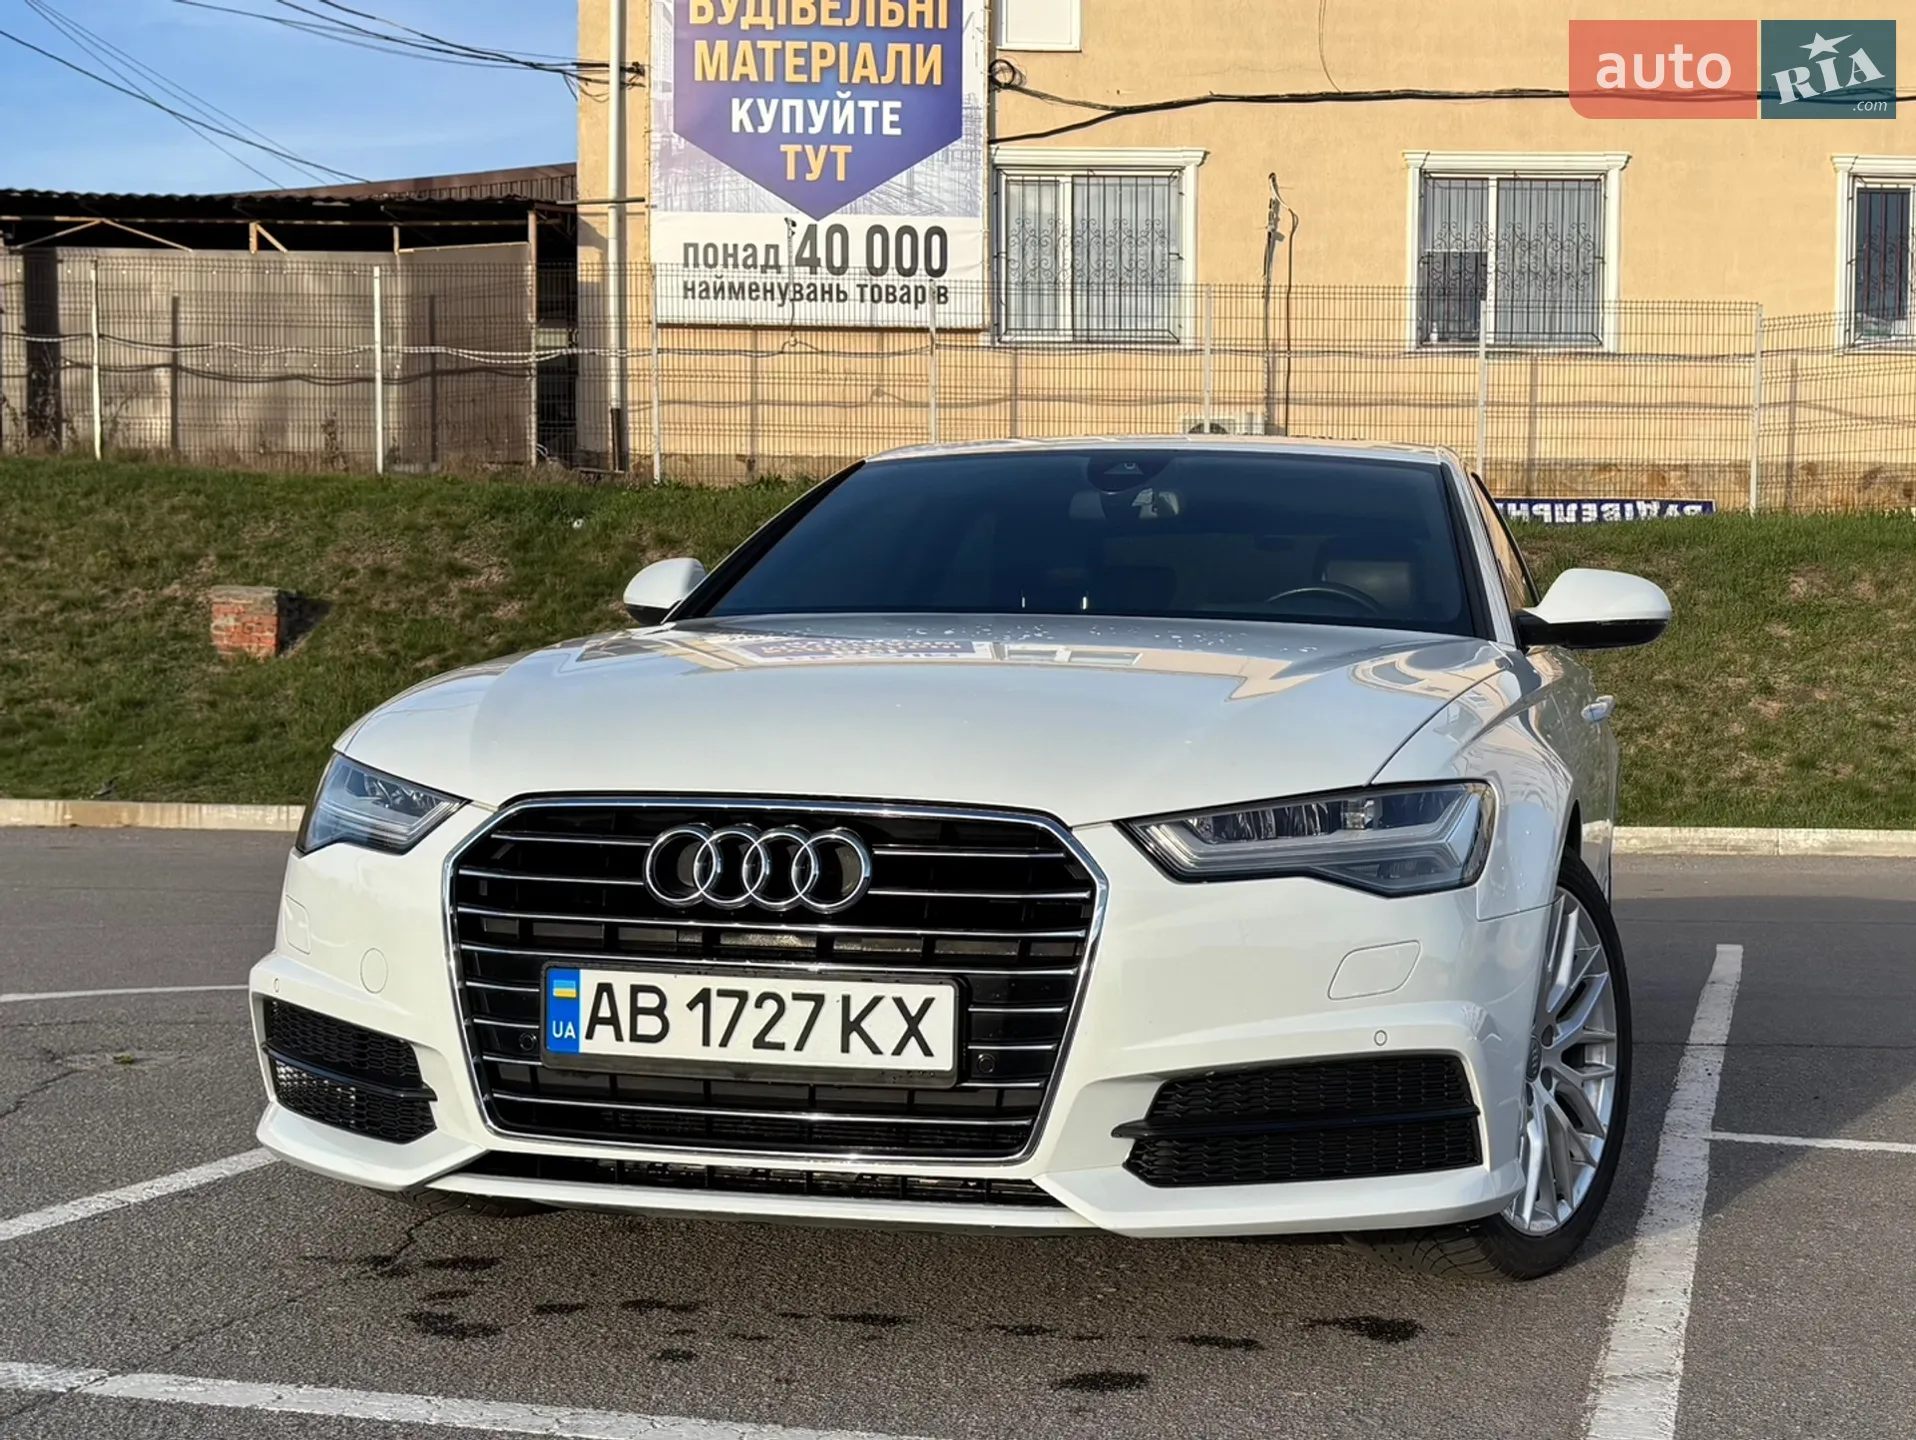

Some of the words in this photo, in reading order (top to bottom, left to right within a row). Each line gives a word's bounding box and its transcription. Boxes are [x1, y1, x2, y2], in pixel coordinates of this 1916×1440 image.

[689, 0, 948, 30] БУДІВЕЛЬНІ
[694, 40, 942, 85] МАТЕРІАЛИ
[731, 90, 902, 135] КУПУЙТЕ
[780, 144, 852, 181] ТУТ
[683, 242, 782, 274] понад
[795, 223, 849, 276] 40
[866, 224, 948, 278] 000
[683, 274, 848, 308] найменувань
[856, 283, 949, 310] товарв
[552, 1021, 577, 1040] UA
[584, 982, 670, 1044] AB
[686, 986, 826, 1052] 1727
[840, 994, 936, 1058] KX
